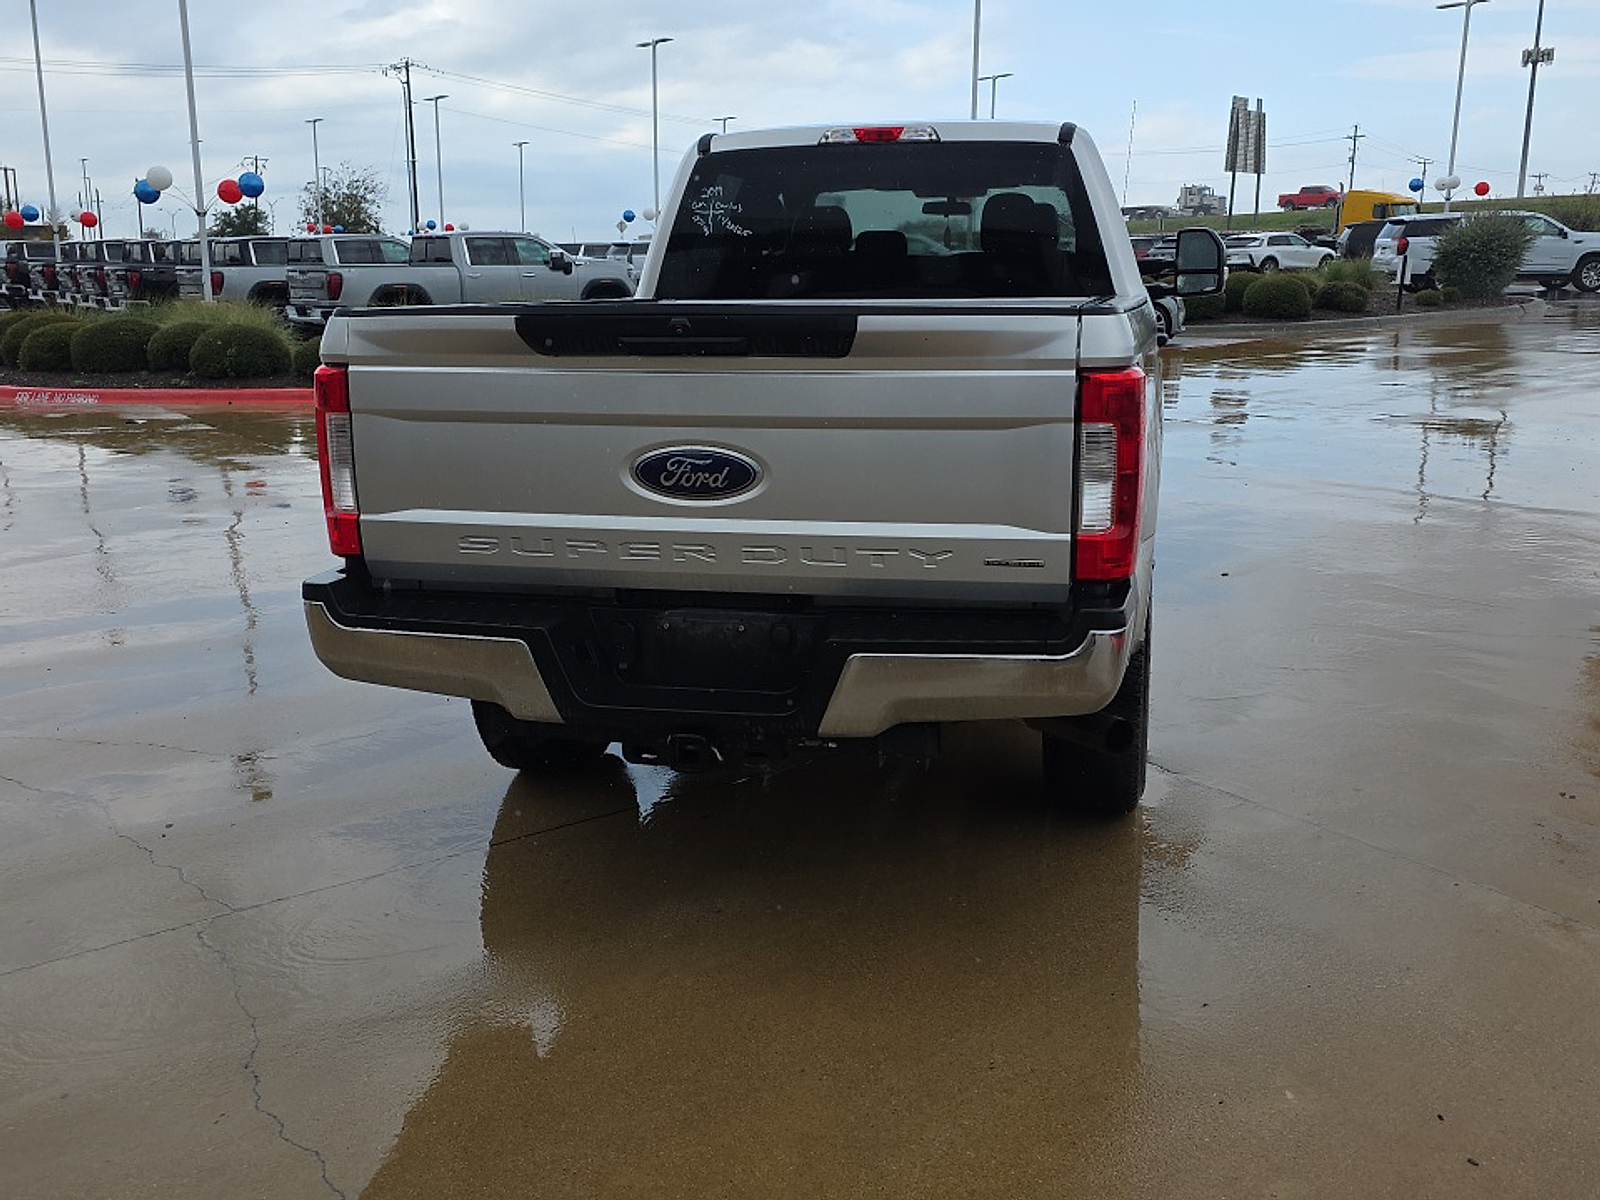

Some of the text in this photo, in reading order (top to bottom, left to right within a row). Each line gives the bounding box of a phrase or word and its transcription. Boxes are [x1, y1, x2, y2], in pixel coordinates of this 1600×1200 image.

[660, 456, 730, 487] Ford
[458, 535, 953, 569] SUPER DUTY
